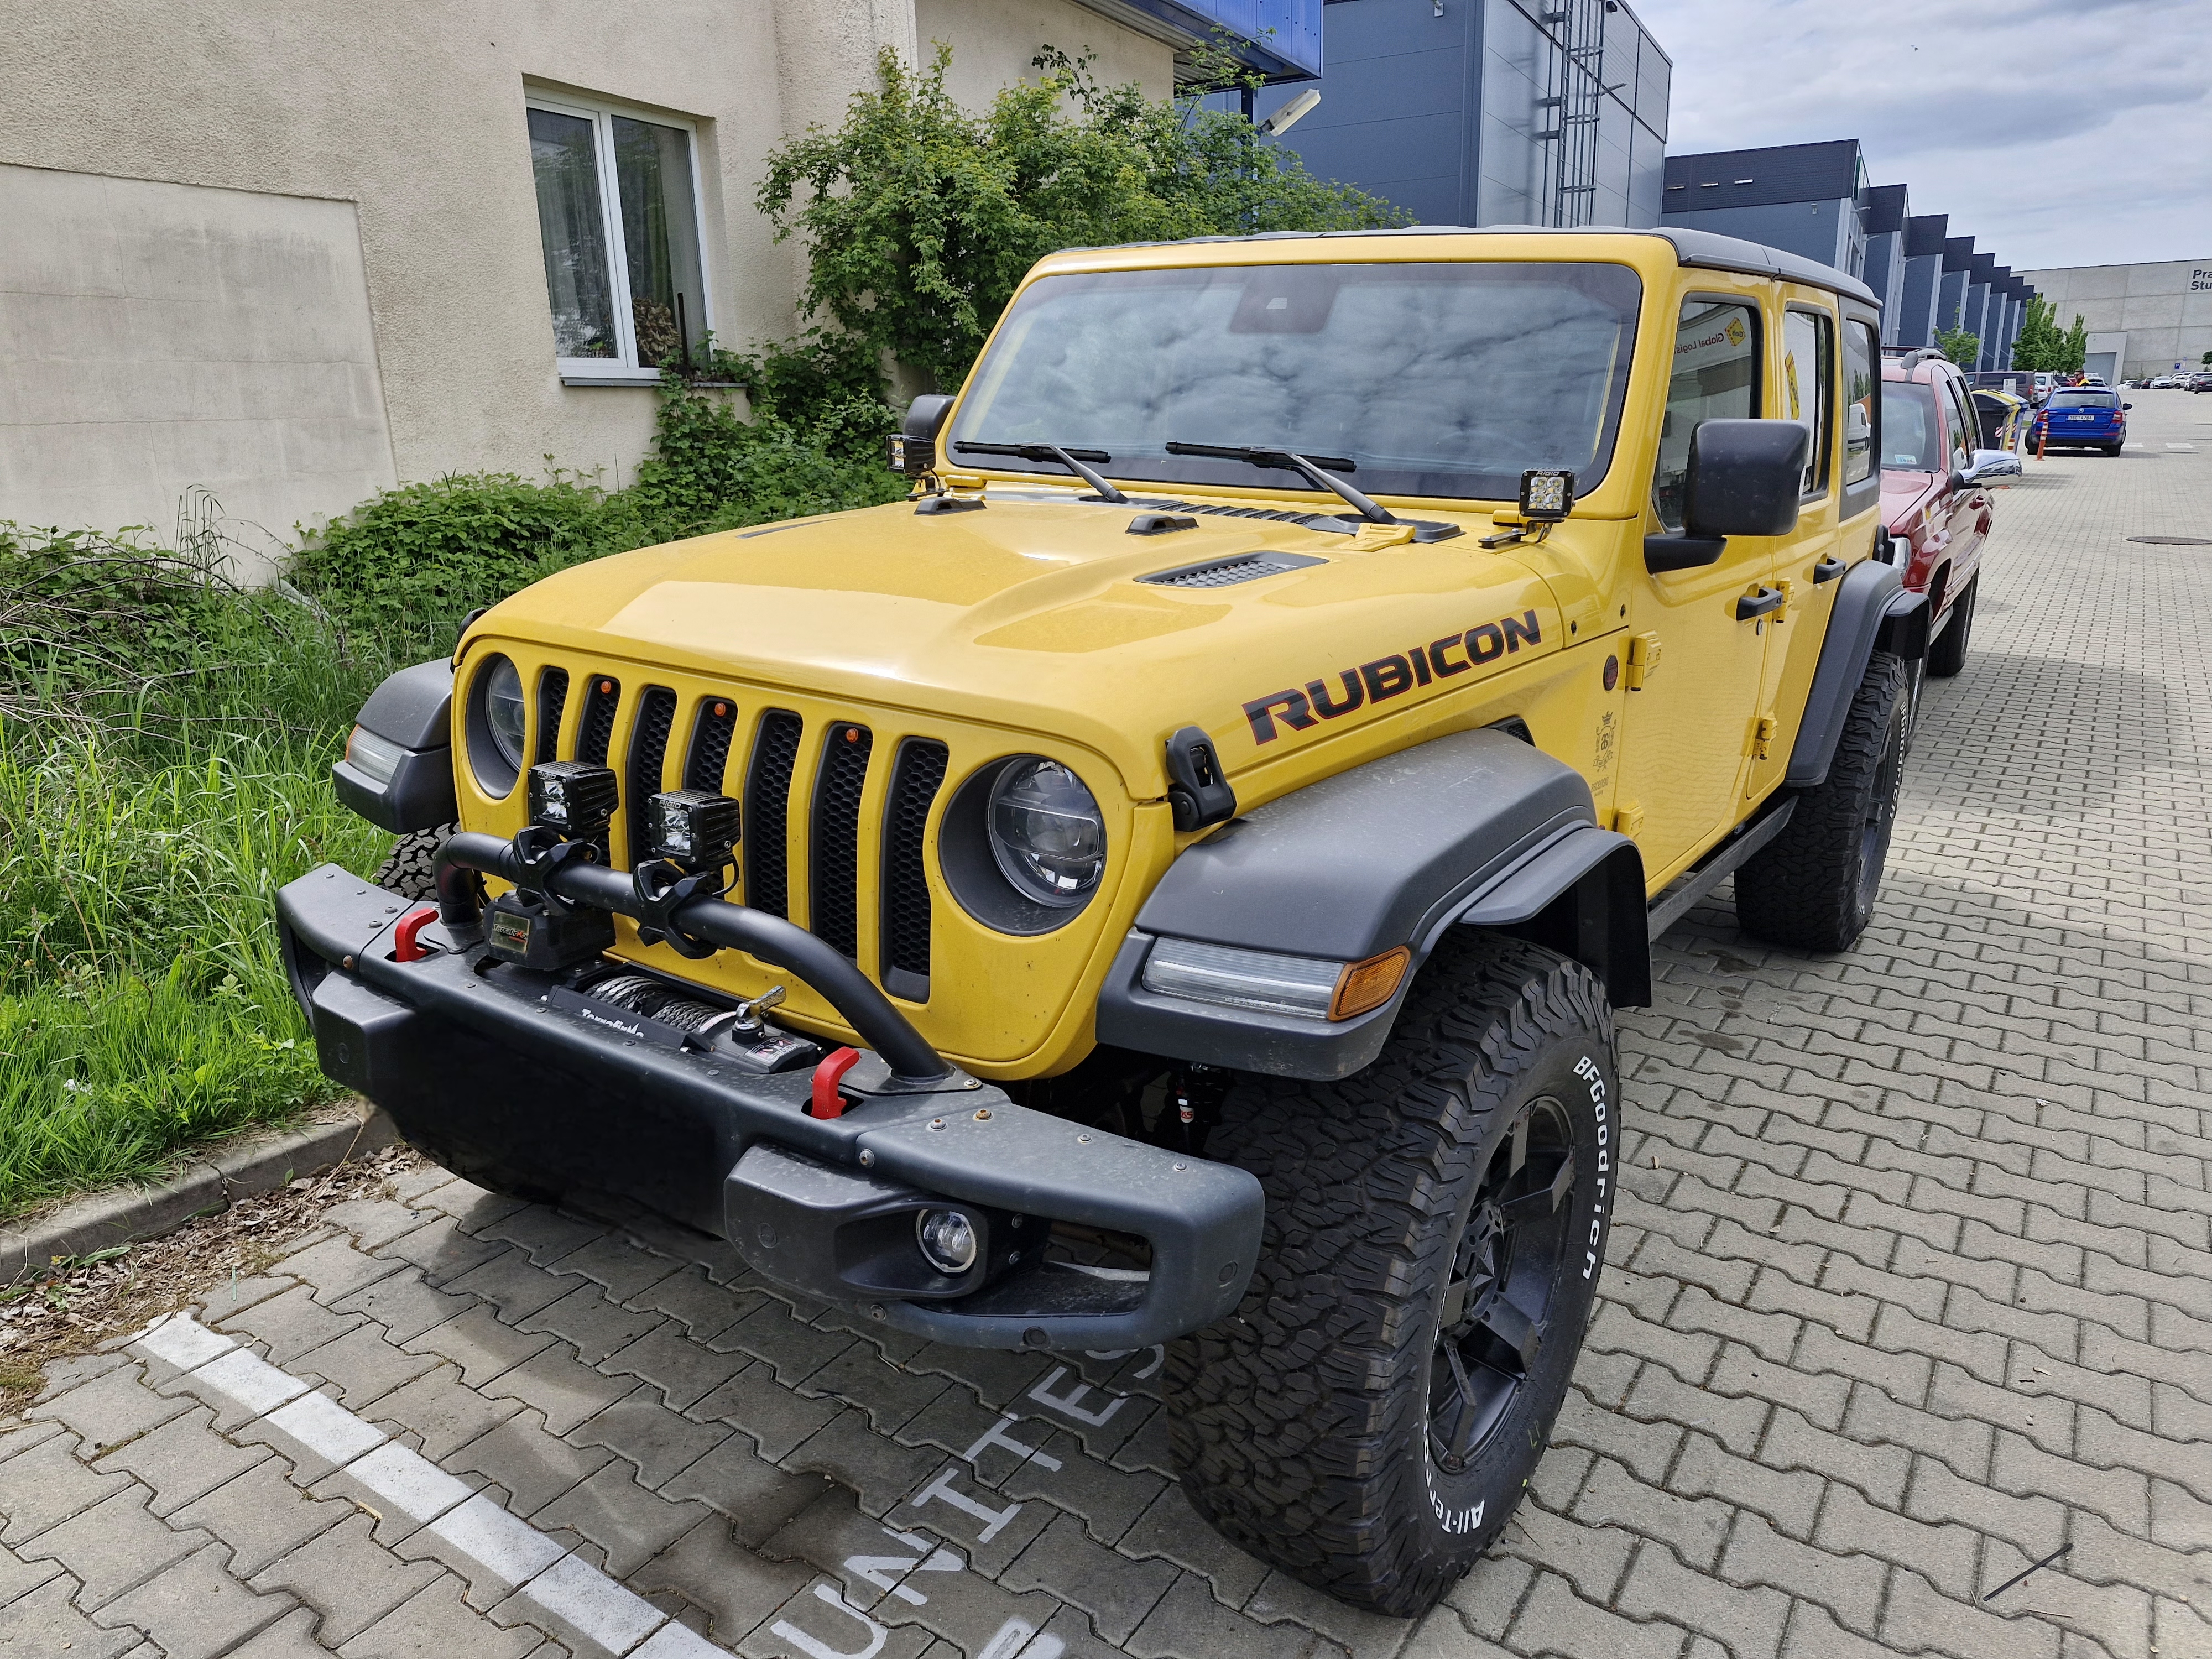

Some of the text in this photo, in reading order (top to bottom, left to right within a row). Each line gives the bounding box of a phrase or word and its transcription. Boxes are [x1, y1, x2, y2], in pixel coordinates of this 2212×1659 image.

[1241, 609, 1541, 746] RUBICON
[537, 770, 556, 780] RIGID
[659, 799, 682, 809] RIGID
[1572, 1055, 1610, 1280] BFGoodrich
